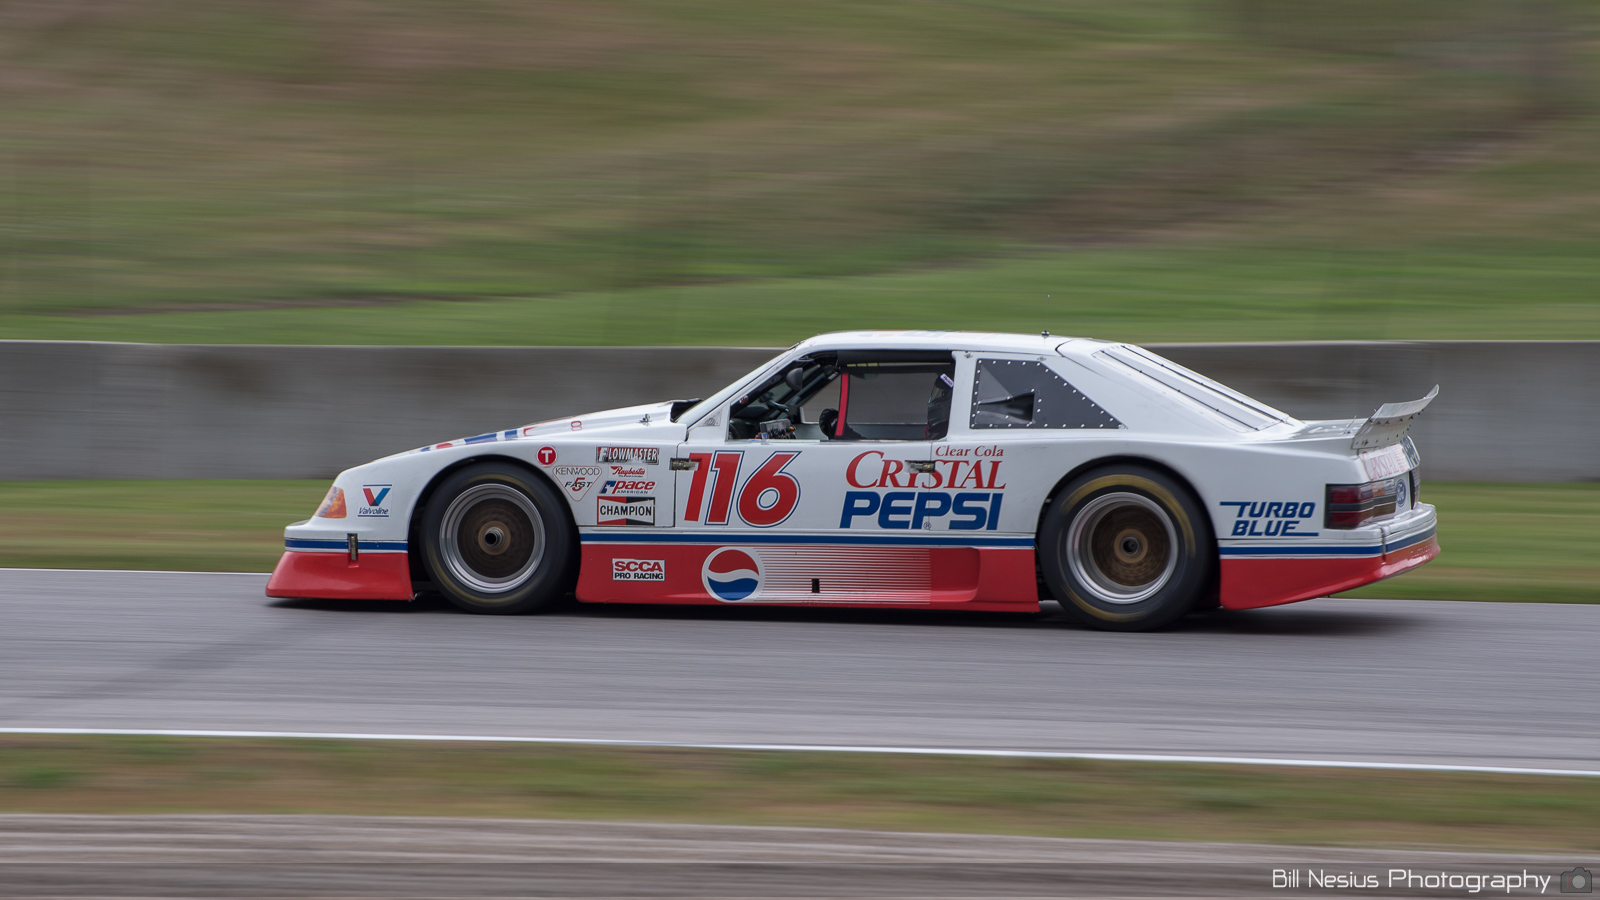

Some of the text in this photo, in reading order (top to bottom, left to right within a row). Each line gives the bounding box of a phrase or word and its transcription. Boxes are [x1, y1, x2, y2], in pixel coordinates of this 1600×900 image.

[599, 447, 657, 461] FLOWMASTER
[935, 445, 1004, 457] Clear Cola
[555, 467, 601, 476] KENWOOD
[684, 450, 803, 528] 116
[358, 507, 389, 515] Valvoline
[600, 505, 652, 516] CHAMPION
[839, 491, 1005, 530] PEPSI
[1219, 501, 1317, 518] TURBO
[1231, 520, 1319, 537] BLUE
[614, 561, 663, 572] SCCA
[614, 572, 664, 580] PRO RACING
